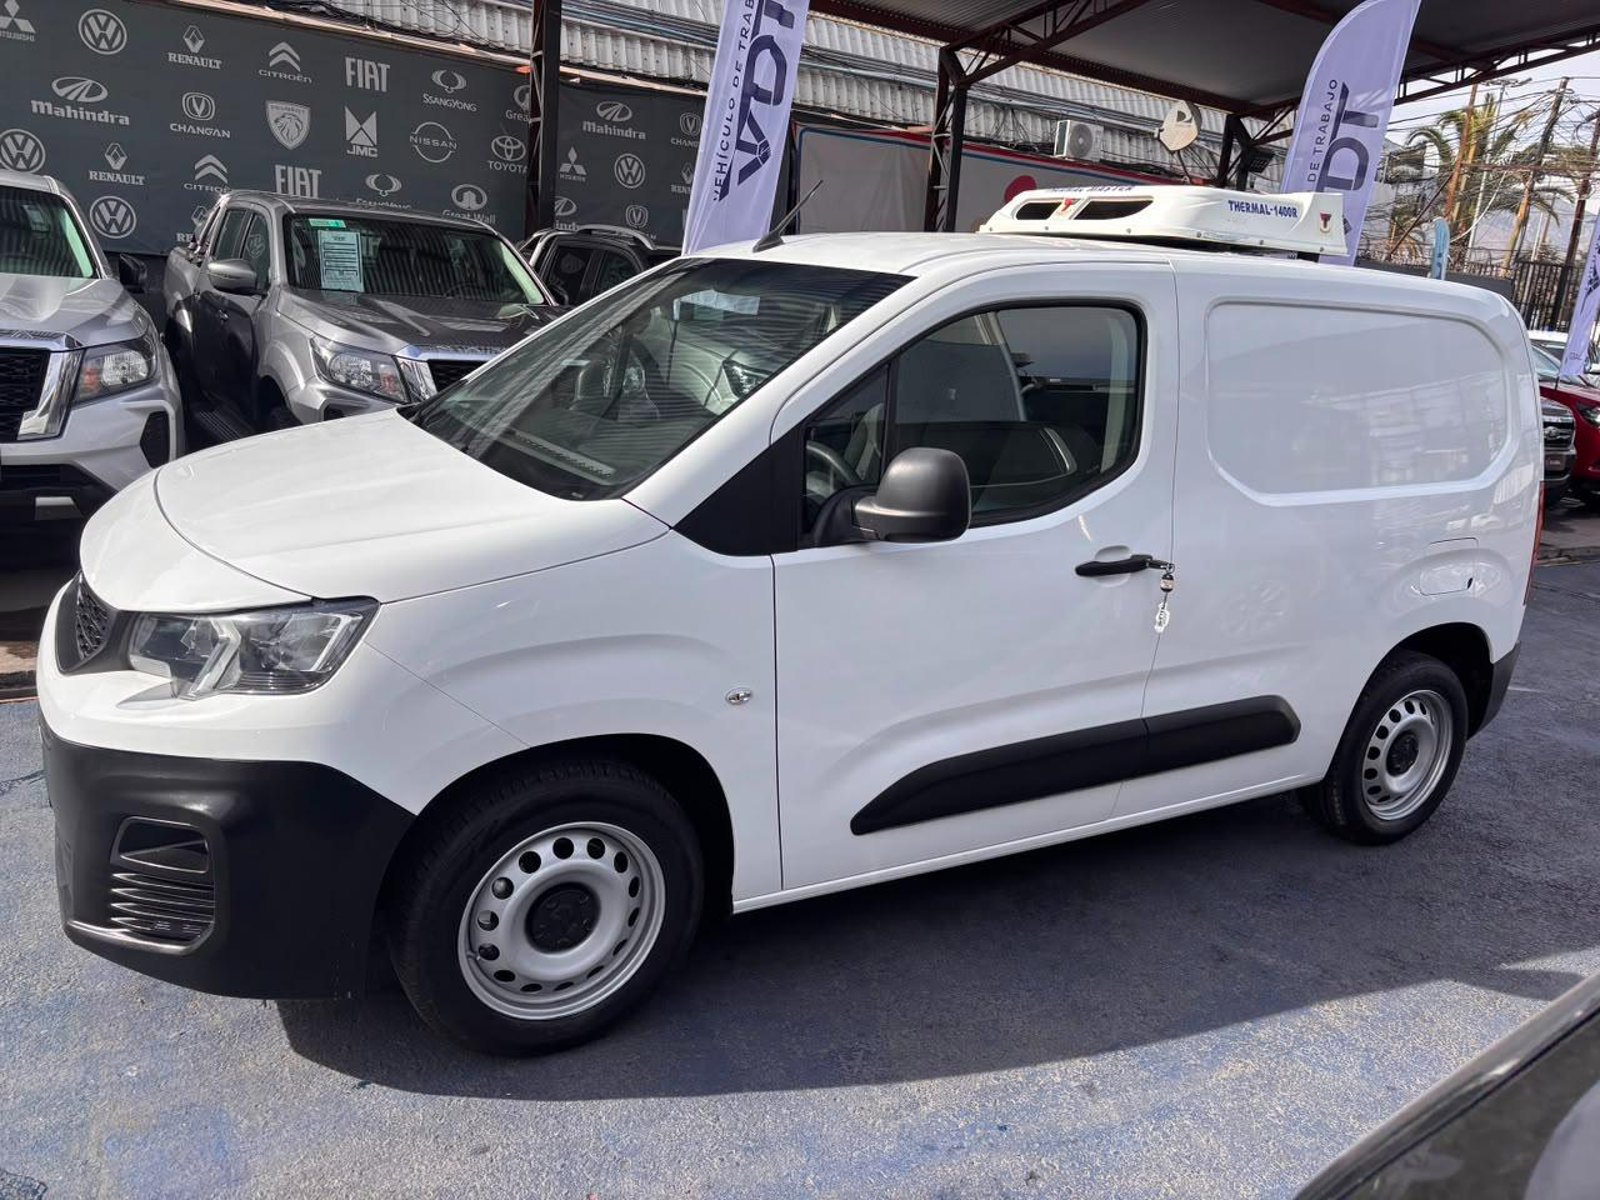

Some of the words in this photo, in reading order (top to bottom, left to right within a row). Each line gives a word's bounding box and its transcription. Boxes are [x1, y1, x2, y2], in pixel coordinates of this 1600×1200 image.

[168, 52, 223, 70] RENAULT
[345, 56, 391, 92] FIAT
[732, 61, 743, 88] DE
[30, 100, 130, 126] Mahindra
[169, 123, 231, 138] CHANGAN
[582, 121, 647, 140] Mahindra
[1307, 161, 1321, 182] DE
[1314, 79, 1338, 156] TRABAJO
[1315, 82, 1379, 193] DT
[346, 145, 378, 158] JMC
[409, 135, 457, 150] NISSAN
[89, 171, 146, 186] RENAULT
[275, 164, 322, 199] FIAT
[1228, 199, 1298, 219] THERMAL-1400R
